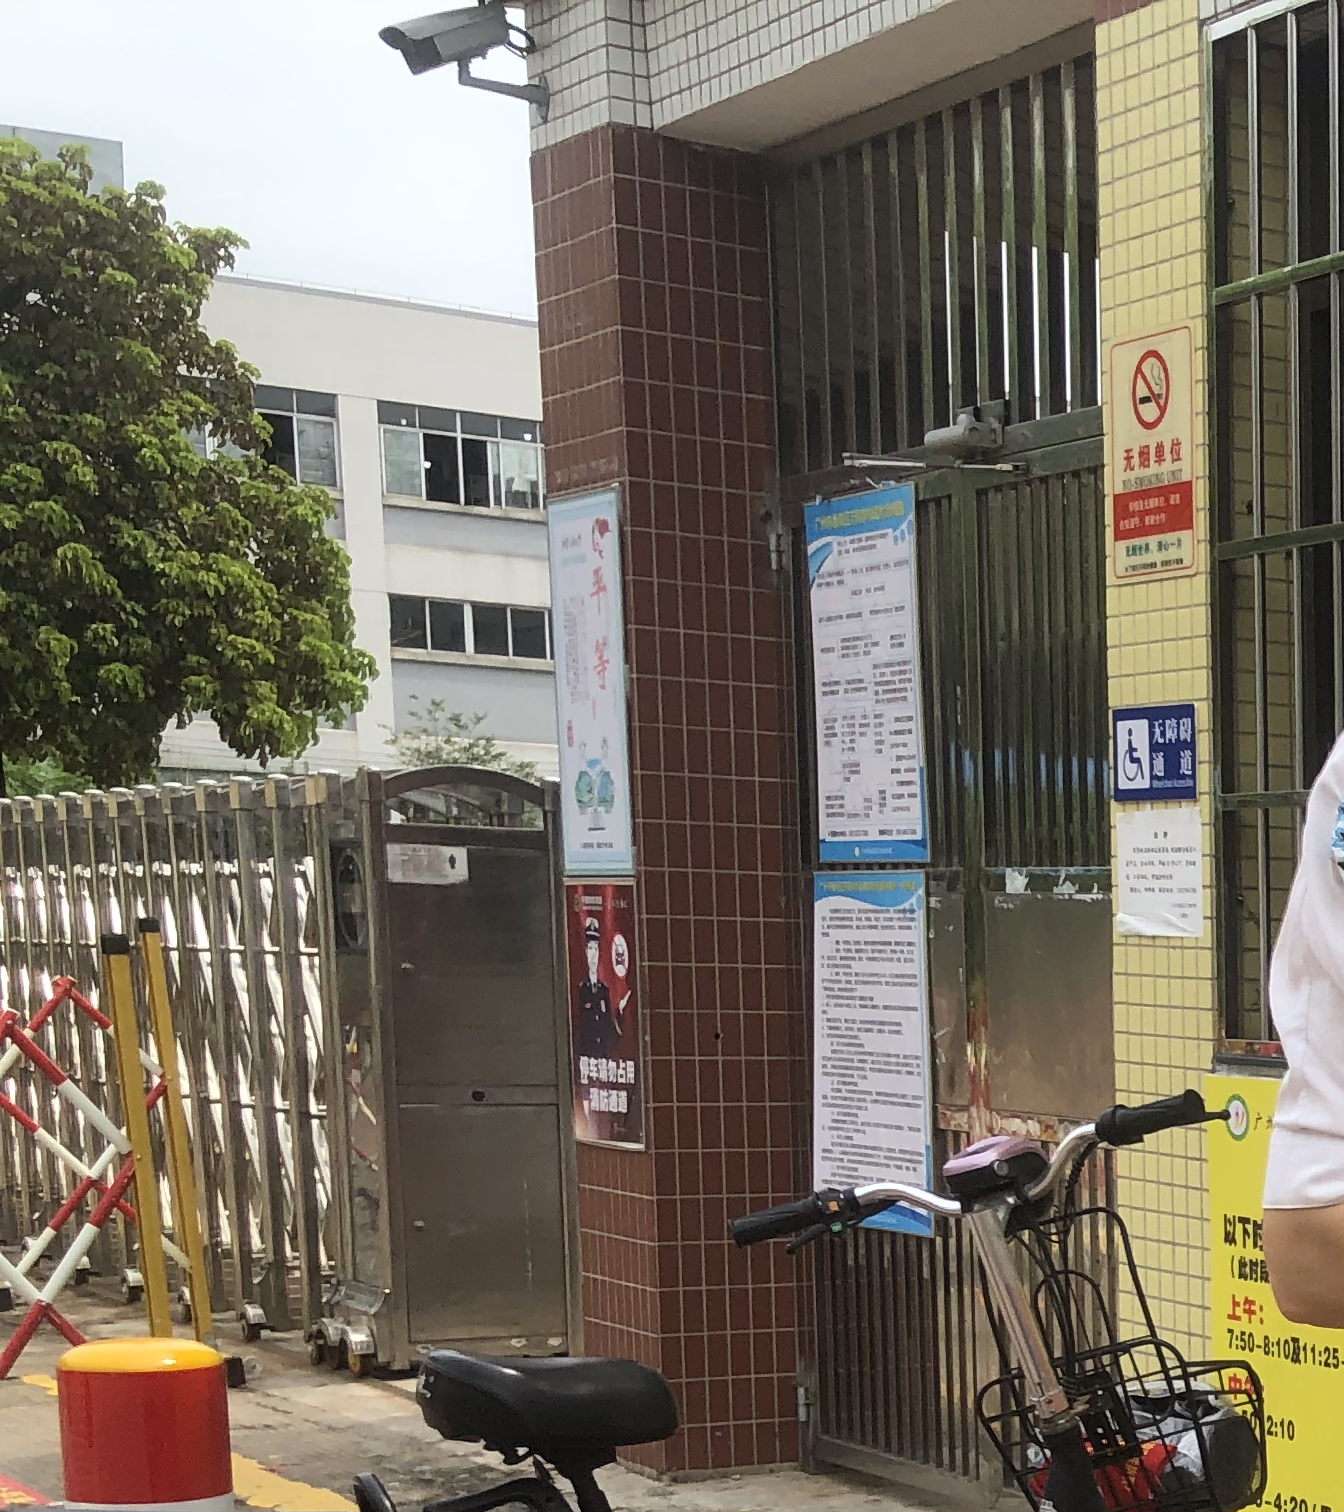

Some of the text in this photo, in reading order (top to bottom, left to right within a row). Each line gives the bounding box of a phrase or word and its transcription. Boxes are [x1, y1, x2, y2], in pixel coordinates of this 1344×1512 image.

[1123, 437, 1183, 473] 无烟单位
[1152, 717, 1193, 745] 无障碍
[1226, 1293, 1264, 1326] 上午：
